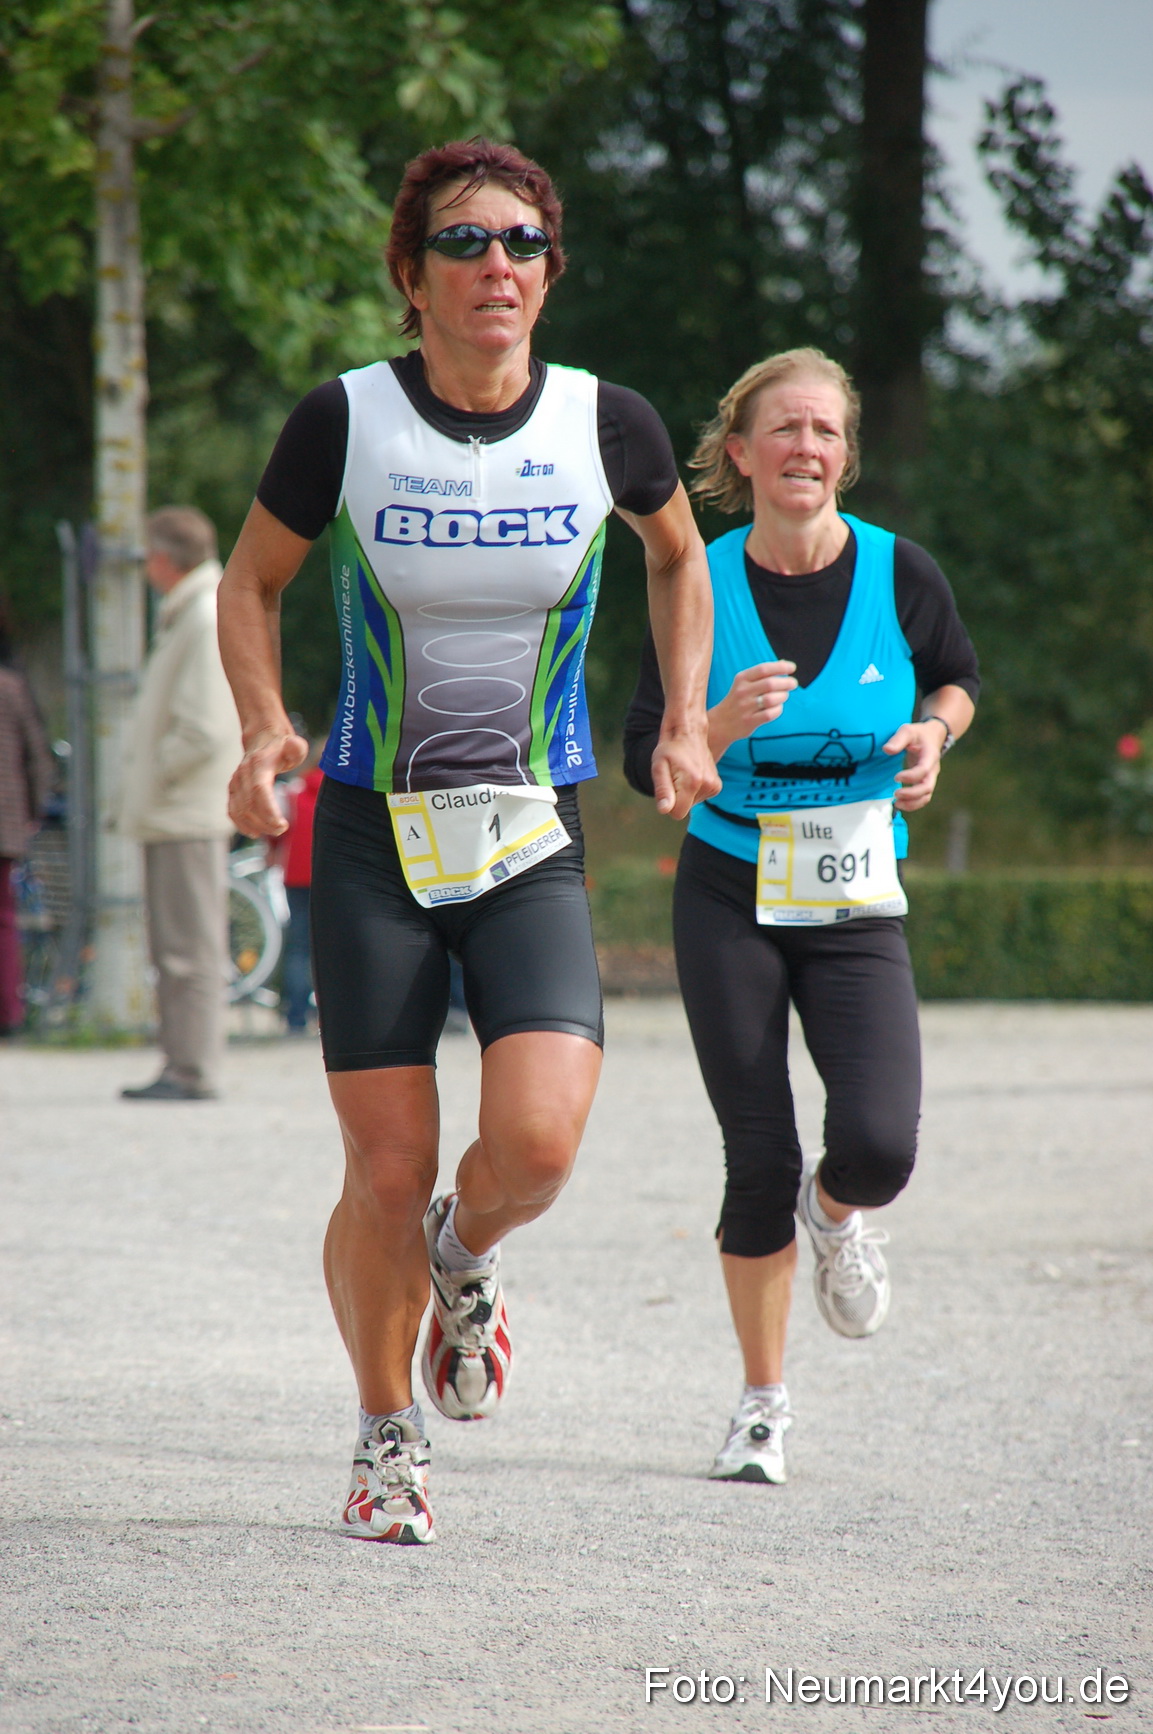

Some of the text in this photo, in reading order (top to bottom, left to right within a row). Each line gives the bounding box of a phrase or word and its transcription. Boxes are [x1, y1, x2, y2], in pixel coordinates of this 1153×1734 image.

[389, 473, 473, 497] TEAM
[374, 503, 580, 547] BOCK
[337, 564, 355, 767] www.bockonline.de
[406, 825, 421, 841] A
[488, 813, 501, 843] 1
[802, 821, 833, 840] Ute
[505, 828, 564, 868] PFLEIDERER
[768, 849, 777, 865] A
[817, 849, 872, 884] 691
[429, 885, 472, 900] BOCK
